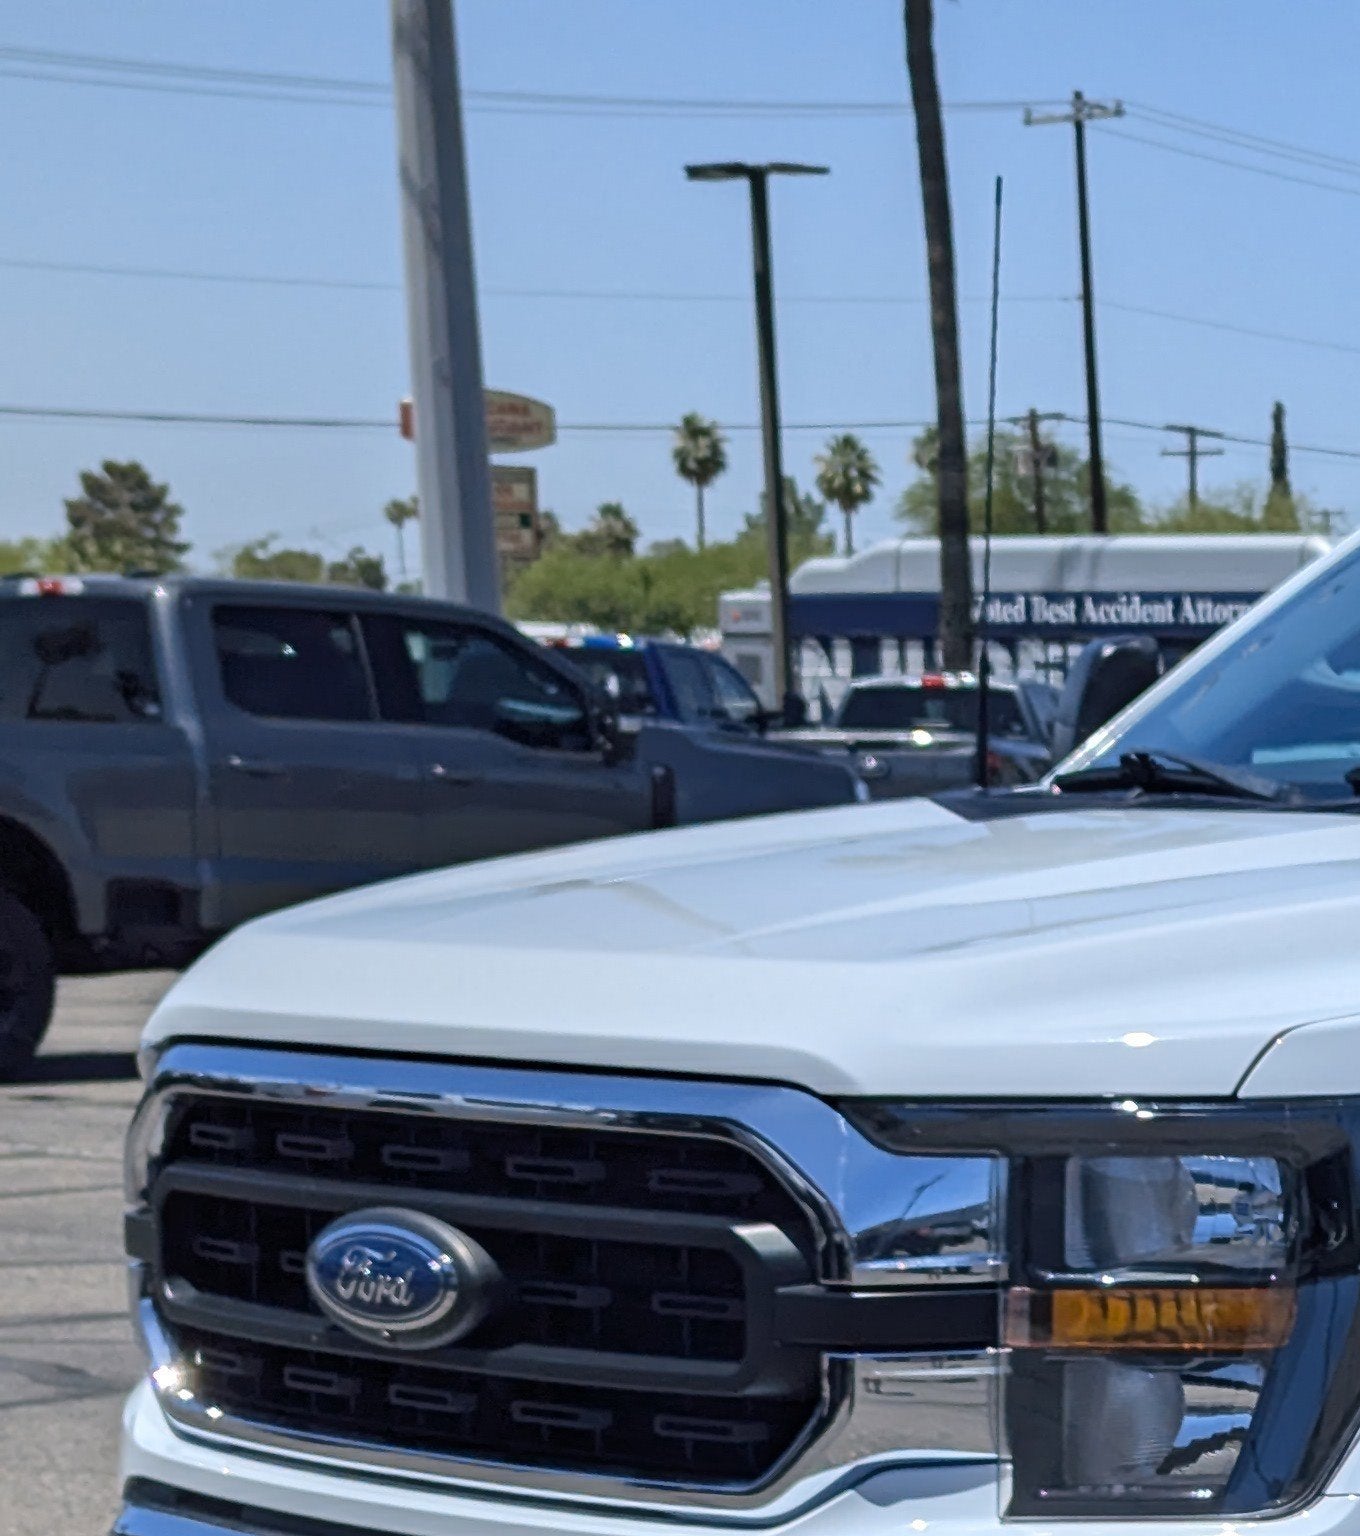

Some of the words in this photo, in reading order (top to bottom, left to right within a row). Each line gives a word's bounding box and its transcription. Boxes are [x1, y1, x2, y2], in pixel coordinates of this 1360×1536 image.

[1030, 594, 1076, 624] Best
[1080, 594, 1175, 624] Accident
[335, 1244, 416, 1307] Ford
